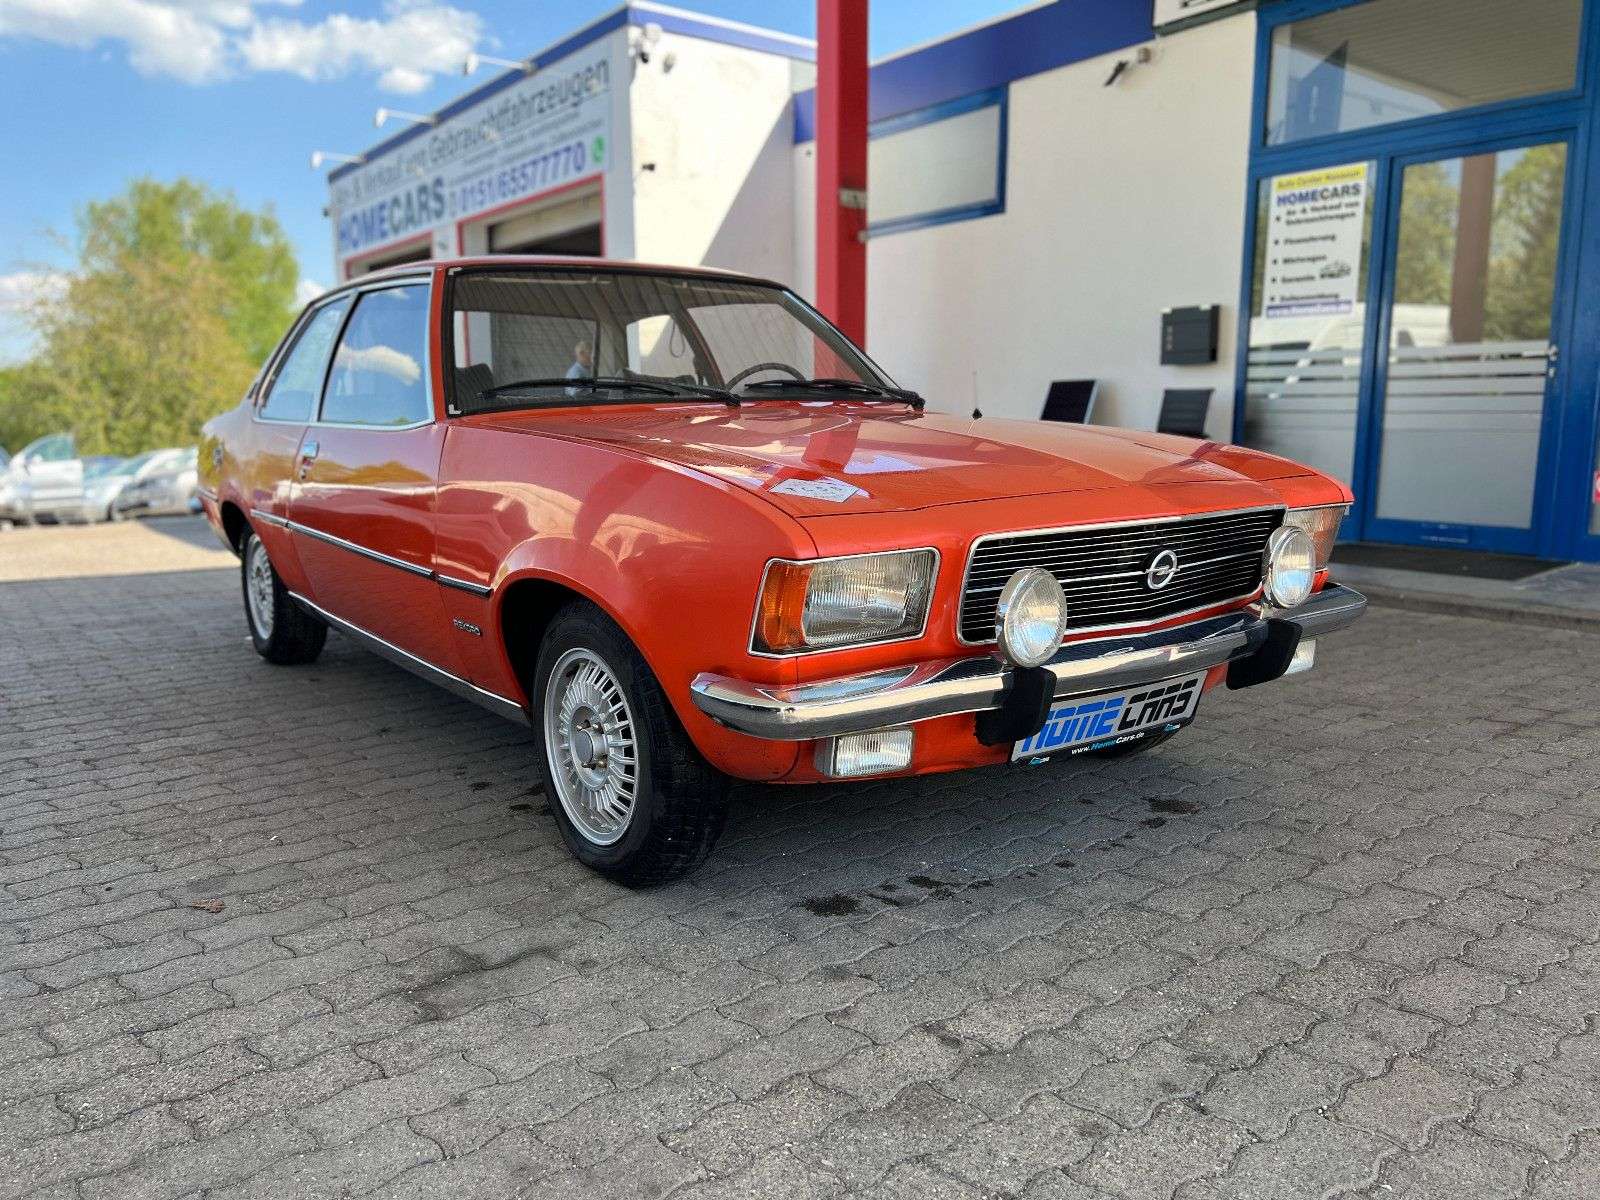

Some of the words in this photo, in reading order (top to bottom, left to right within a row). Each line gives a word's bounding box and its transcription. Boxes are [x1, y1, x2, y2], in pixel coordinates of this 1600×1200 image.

[339, 177, 445, 252] HOMECARS
[1277, 183, 1361, 206] HOMECARS
[1118, 678, 1198, 731] CARS
